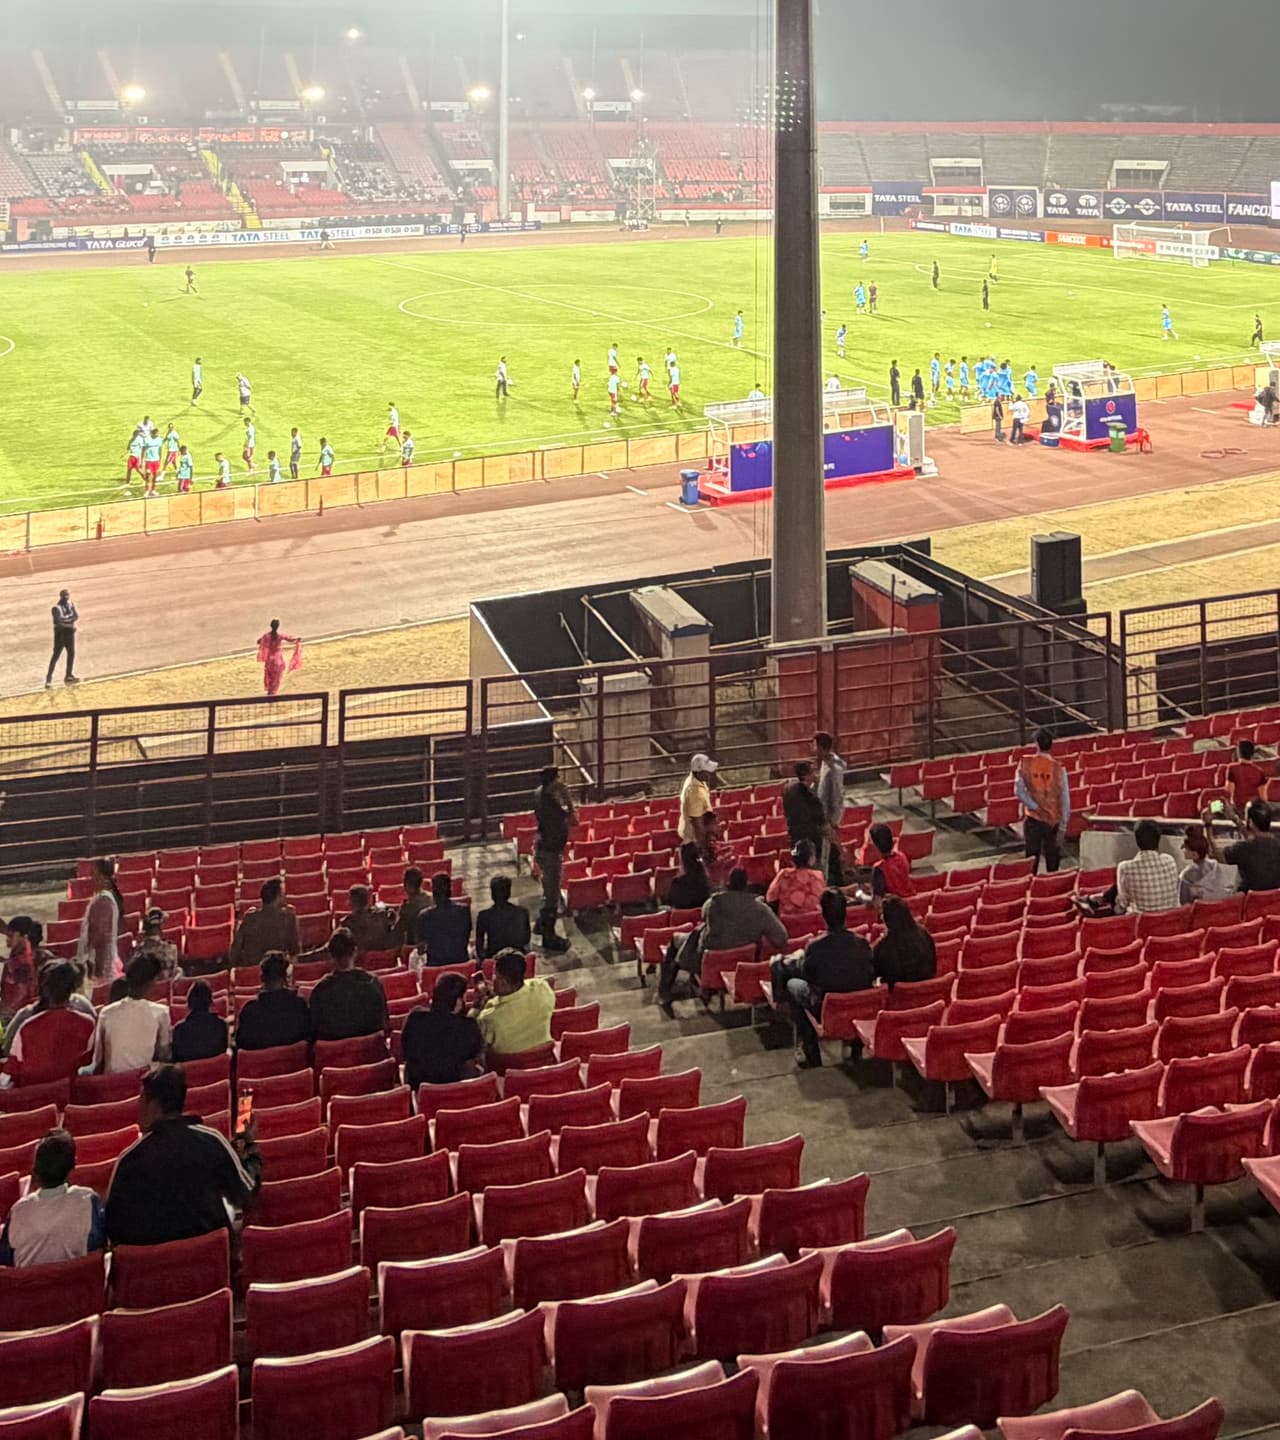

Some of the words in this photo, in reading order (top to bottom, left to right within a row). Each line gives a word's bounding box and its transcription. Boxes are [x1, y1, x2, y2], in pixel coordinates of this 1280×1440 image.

[874, 194, 897, 202] TATA
[898, 195, 921, 203] STEEL
[1046, 206, 1070, 215] TATA
[1075, 208, 1100, 216] TATA
[1165, 202, 1193, 212] TATA
[1194, 204, 1223, 214] STEEL
[954, 224, 973, 233] TATA
[232, 233, 260, 242] TATA
[263, 232, 289, 241] STEEL
[300, 231, 320, 239] TAT
[330, 229, 356, 238] STEEL
[86, 239, 114, 249] TATA
